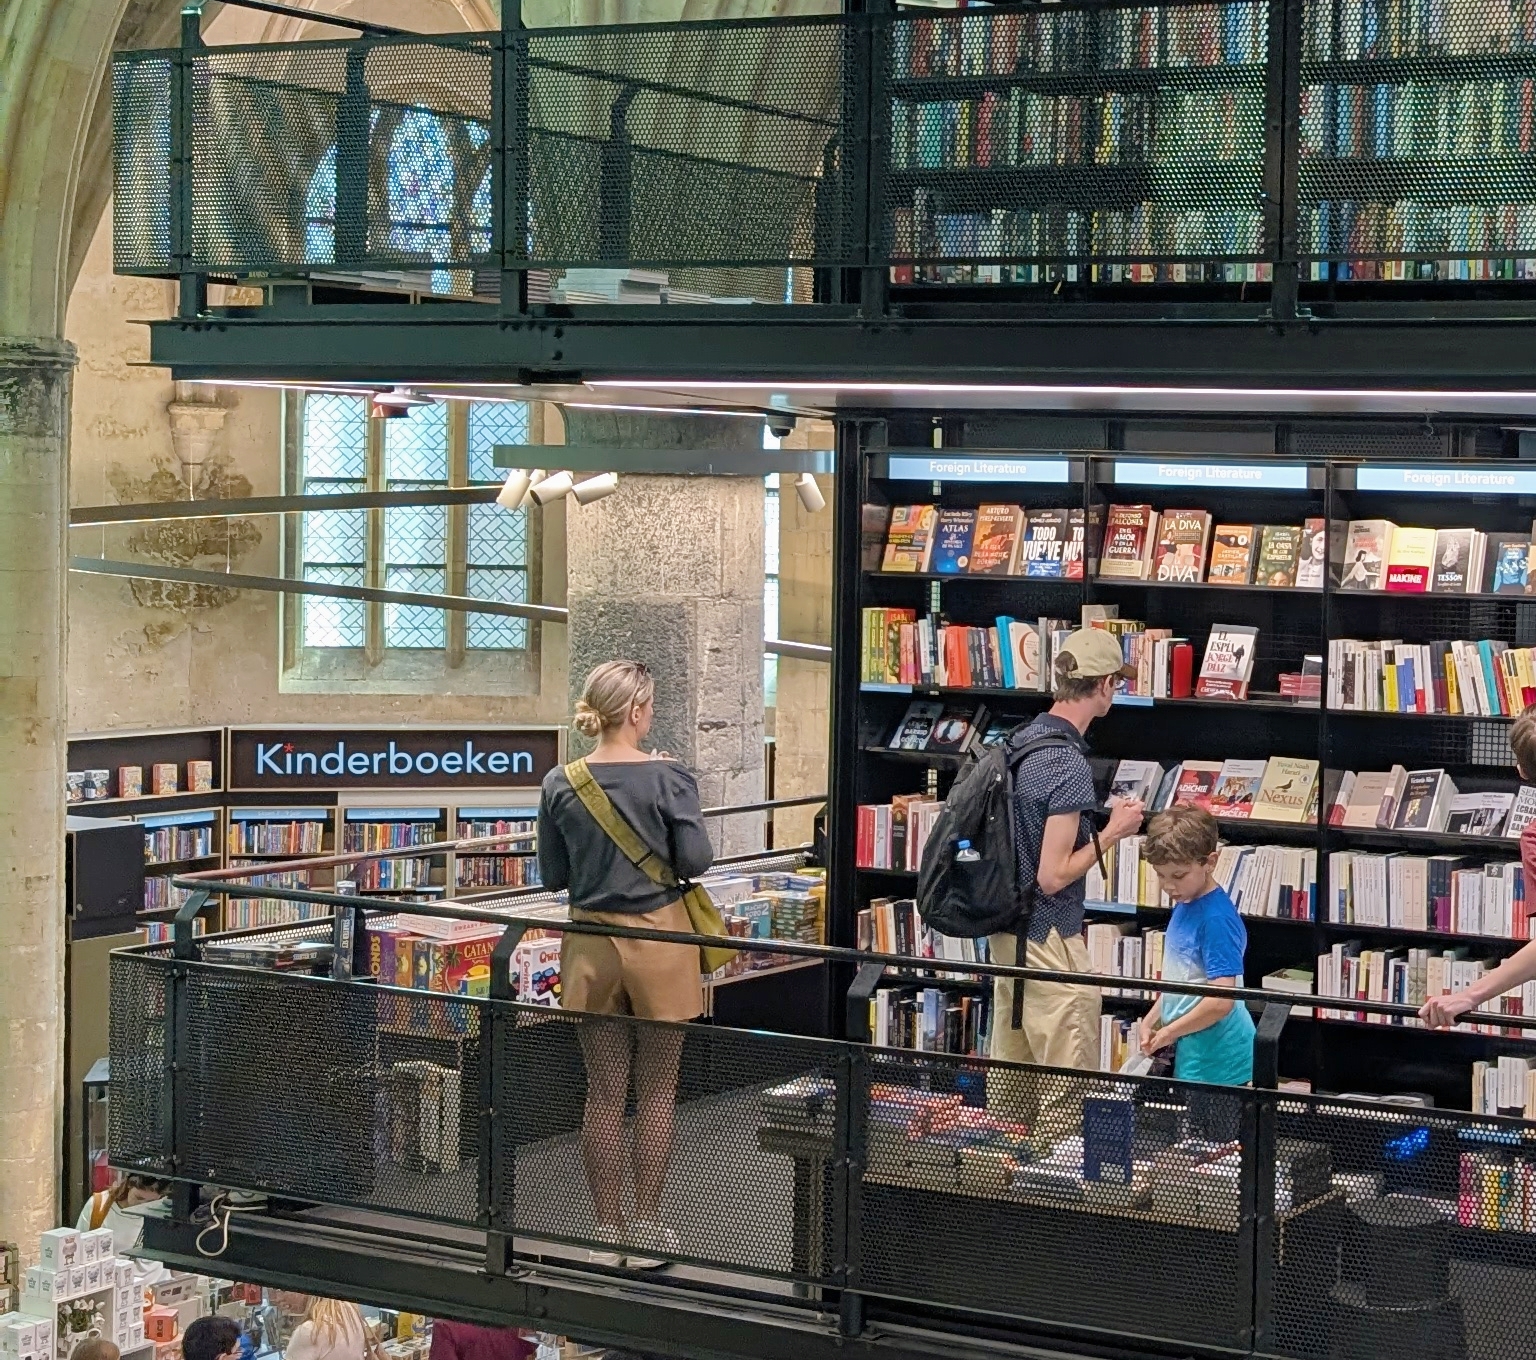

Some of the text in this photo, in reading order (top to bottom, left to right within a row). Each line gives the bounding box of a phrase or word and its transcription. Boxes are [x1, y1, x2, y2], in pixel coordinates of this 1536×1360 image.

[929, 460, 1027, 476] Foreign Literature
[1158, 465, 1262, 481] Foreign Literature
[1403, 469, 1515, 487] Foreign Literature
[986, 507, 1009, 515] ARTURO
[942, 525, 969, 533] ATLAS
[1164, 520, 1201, 530] LA DIVA
[1032, 526, 1056, 541] TODO
[1113, 533, 1135, 541] AMOR
[1023, 541, 1061, 561] VUELVE
[1108, 546, 1137, 554] GUERRA
[1158, 564, 1194, 582] DIVA
[1389, 573, 1423, 583] MAKINE
[1218, 631, 1228, 641] EL
[1210, 641, 1235, 653] ESPÍA
[1205, 652, 1233, 663] JORGE
[1206, 661, 1226, 673] DÍAZ
[256, 742, 533, 776] Kinderboeken
[1177, 784, 1208, 792] ADICHIE
[1262, 789, 1304, 806] Nexus
[464, 942, 494, 959] CATAN
